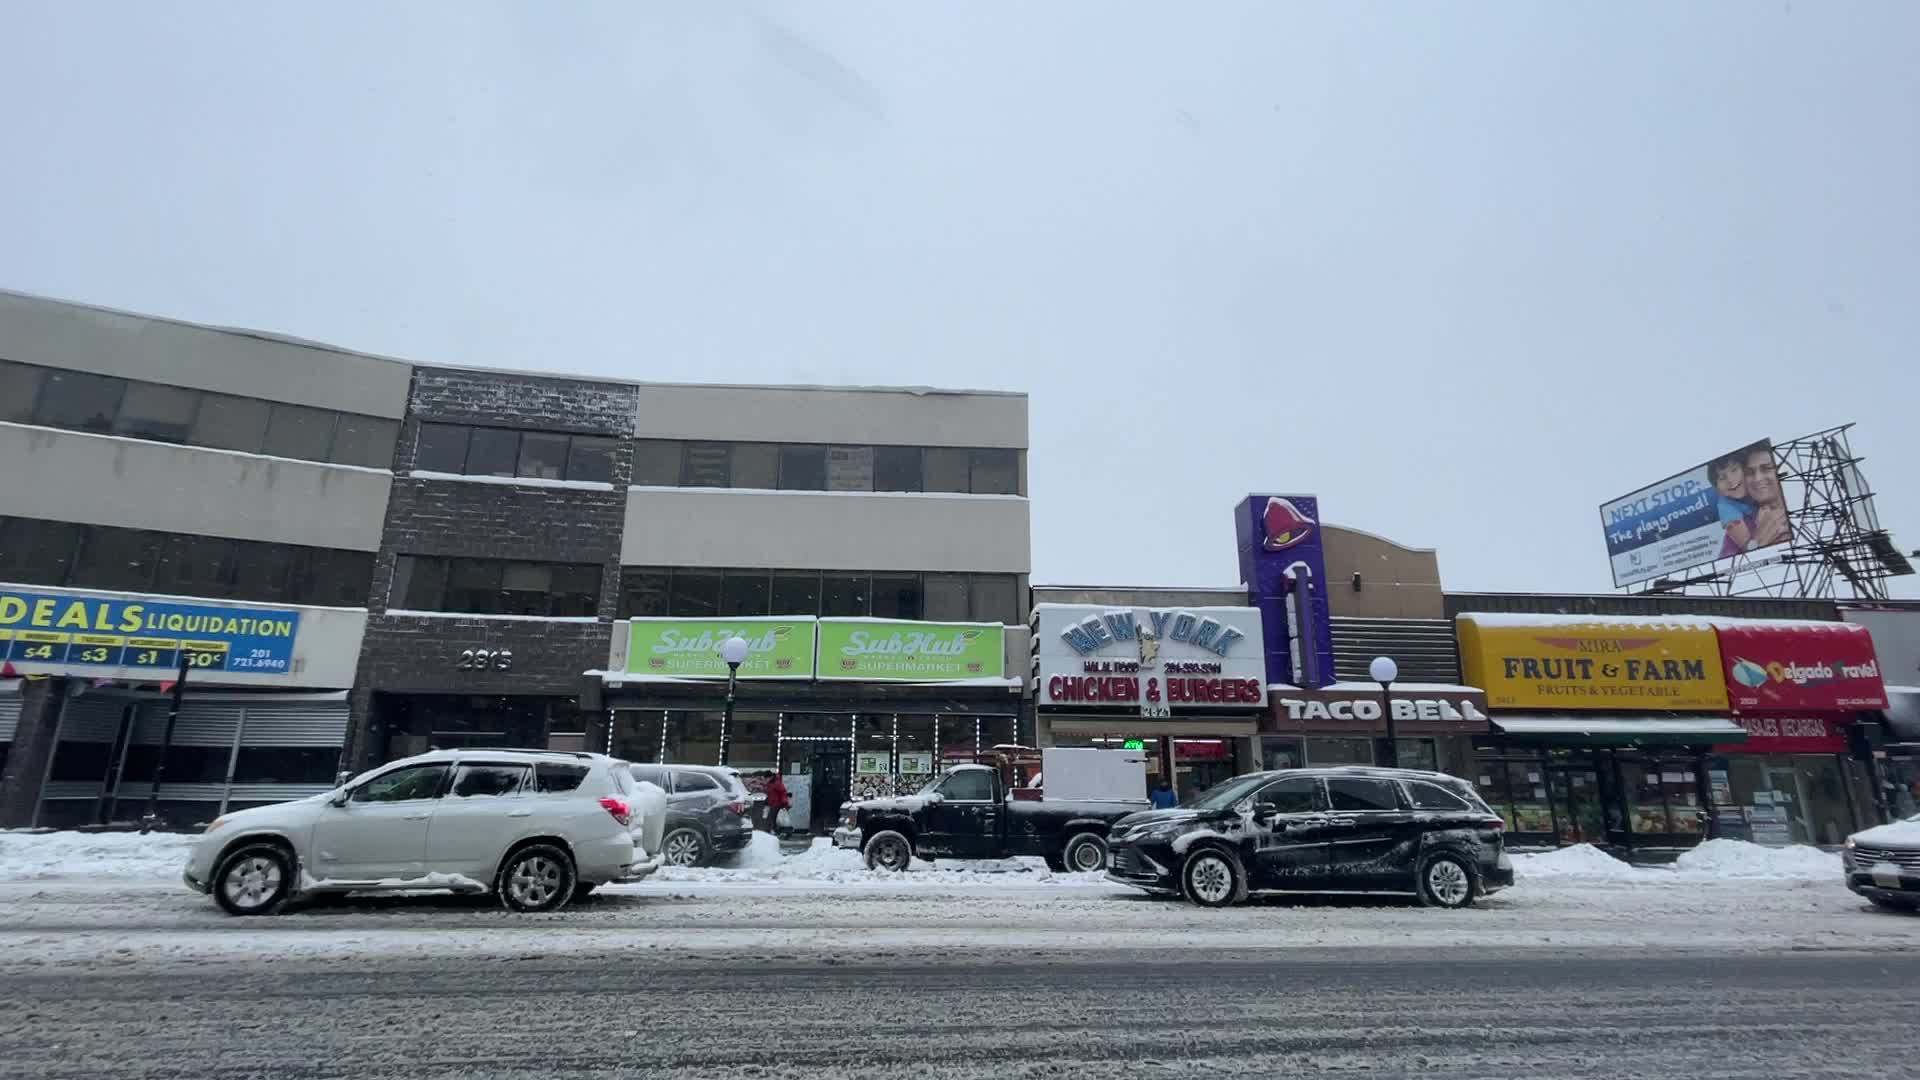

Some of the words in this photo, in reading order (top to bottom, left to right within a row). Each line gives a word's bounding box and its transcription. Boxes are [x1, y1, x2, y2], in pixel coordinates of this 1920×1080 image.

[1609, 497, 1647, 524] NEXT
[0, 596, 145, 632] DEALS
[146, 613, 292, 637] LIQUIDATION
[841, 631, 968, 656] SubHub
[1060, 610, 1138, 657] NEW
[1149, 610, 1247, 658] YORK
[1577, 639, 1623, 653] MIRA
[250, 649, 272, 658] 201
[666, 660, 770, 671] SUPERMRKET
[858, 661, 961, 673] SUPERMARKET
[1503, 657, 1594, 680] FRUIT
[1601, 663, 1620, 678] &
[1624, 658, 1706, 681] FARM
[1767, 660, 1833, 684] Delgado
[1049, 676, 1140, 703] CHICKEN
[1145, 677, 1162, 703] &
[1166, 678, 1262, 704] BURGERS
[1279, 698, 1382, 720] TACO
[1390, 699, 1488, 721] BELL
